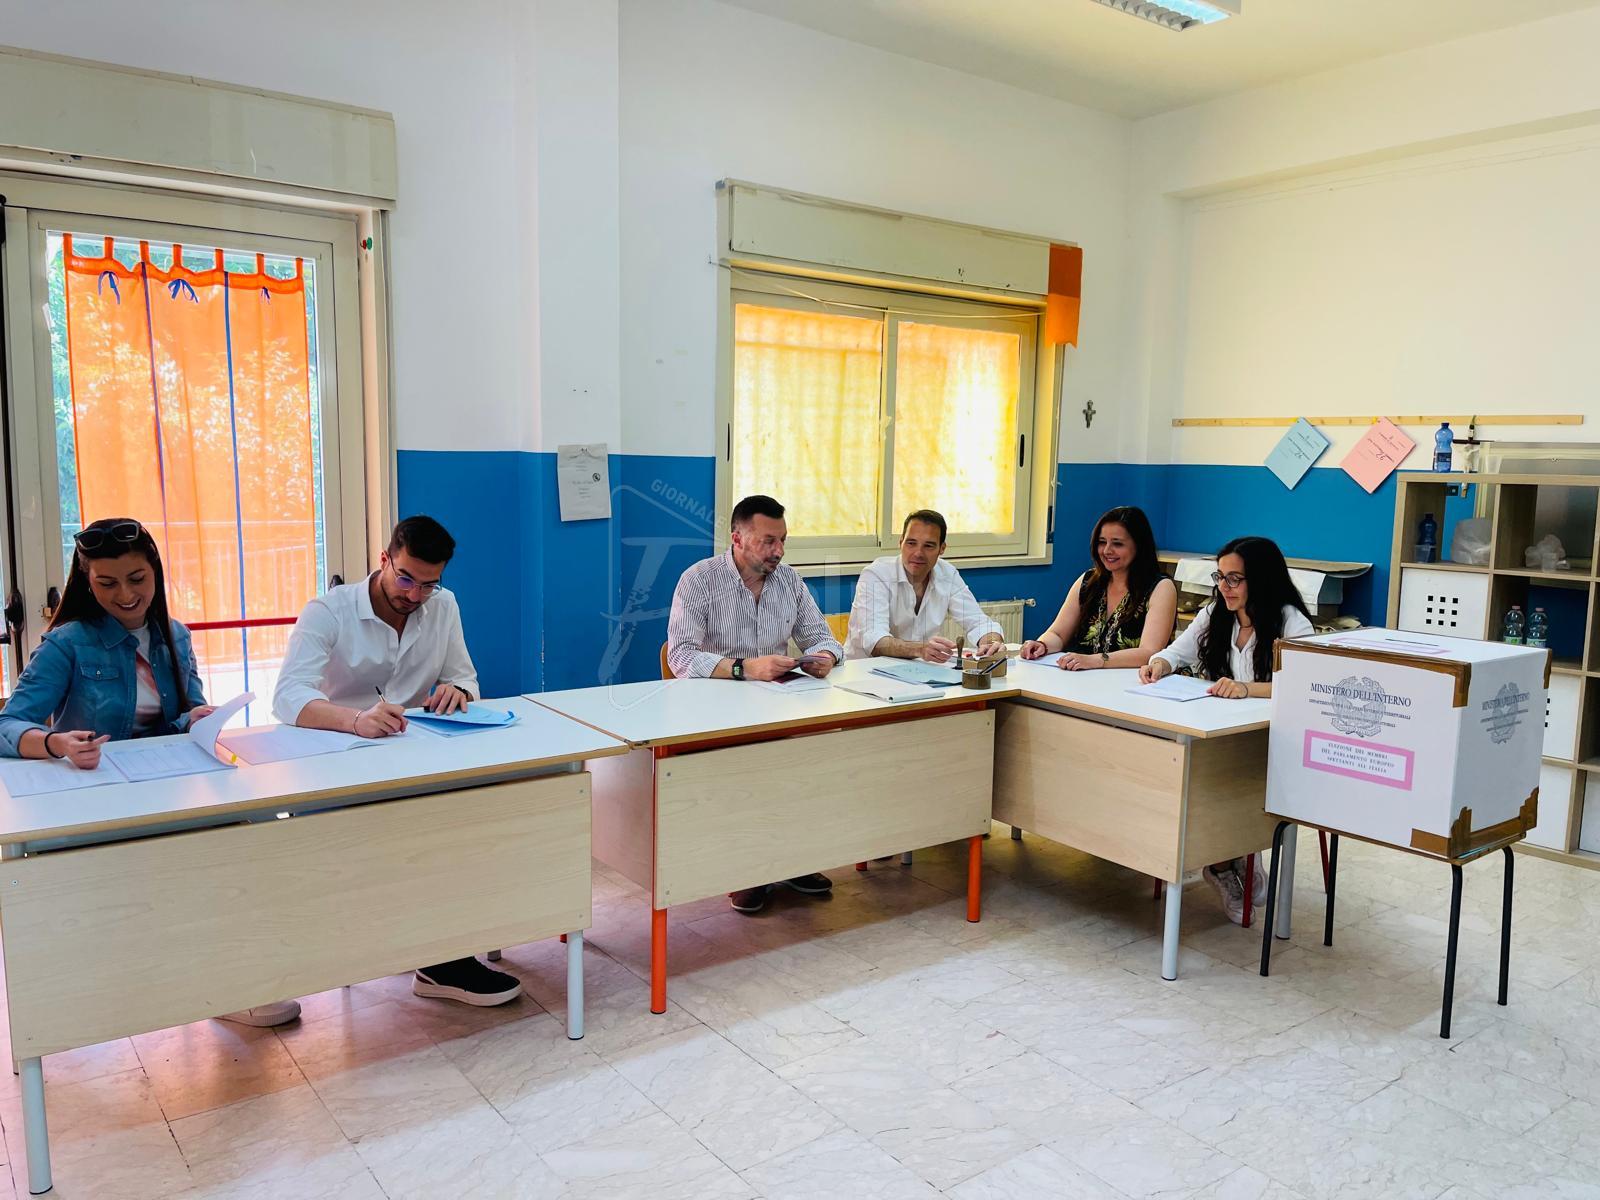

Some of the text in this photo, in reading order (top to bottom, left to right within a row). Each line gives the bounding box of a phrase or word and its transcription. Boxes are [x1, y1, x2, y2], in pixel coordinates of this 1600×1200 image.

[1310, 682, 1412, 707] MINISTERO DELL'INTERNO
[1333, 751, 1367, 762] PARLAMENTO
